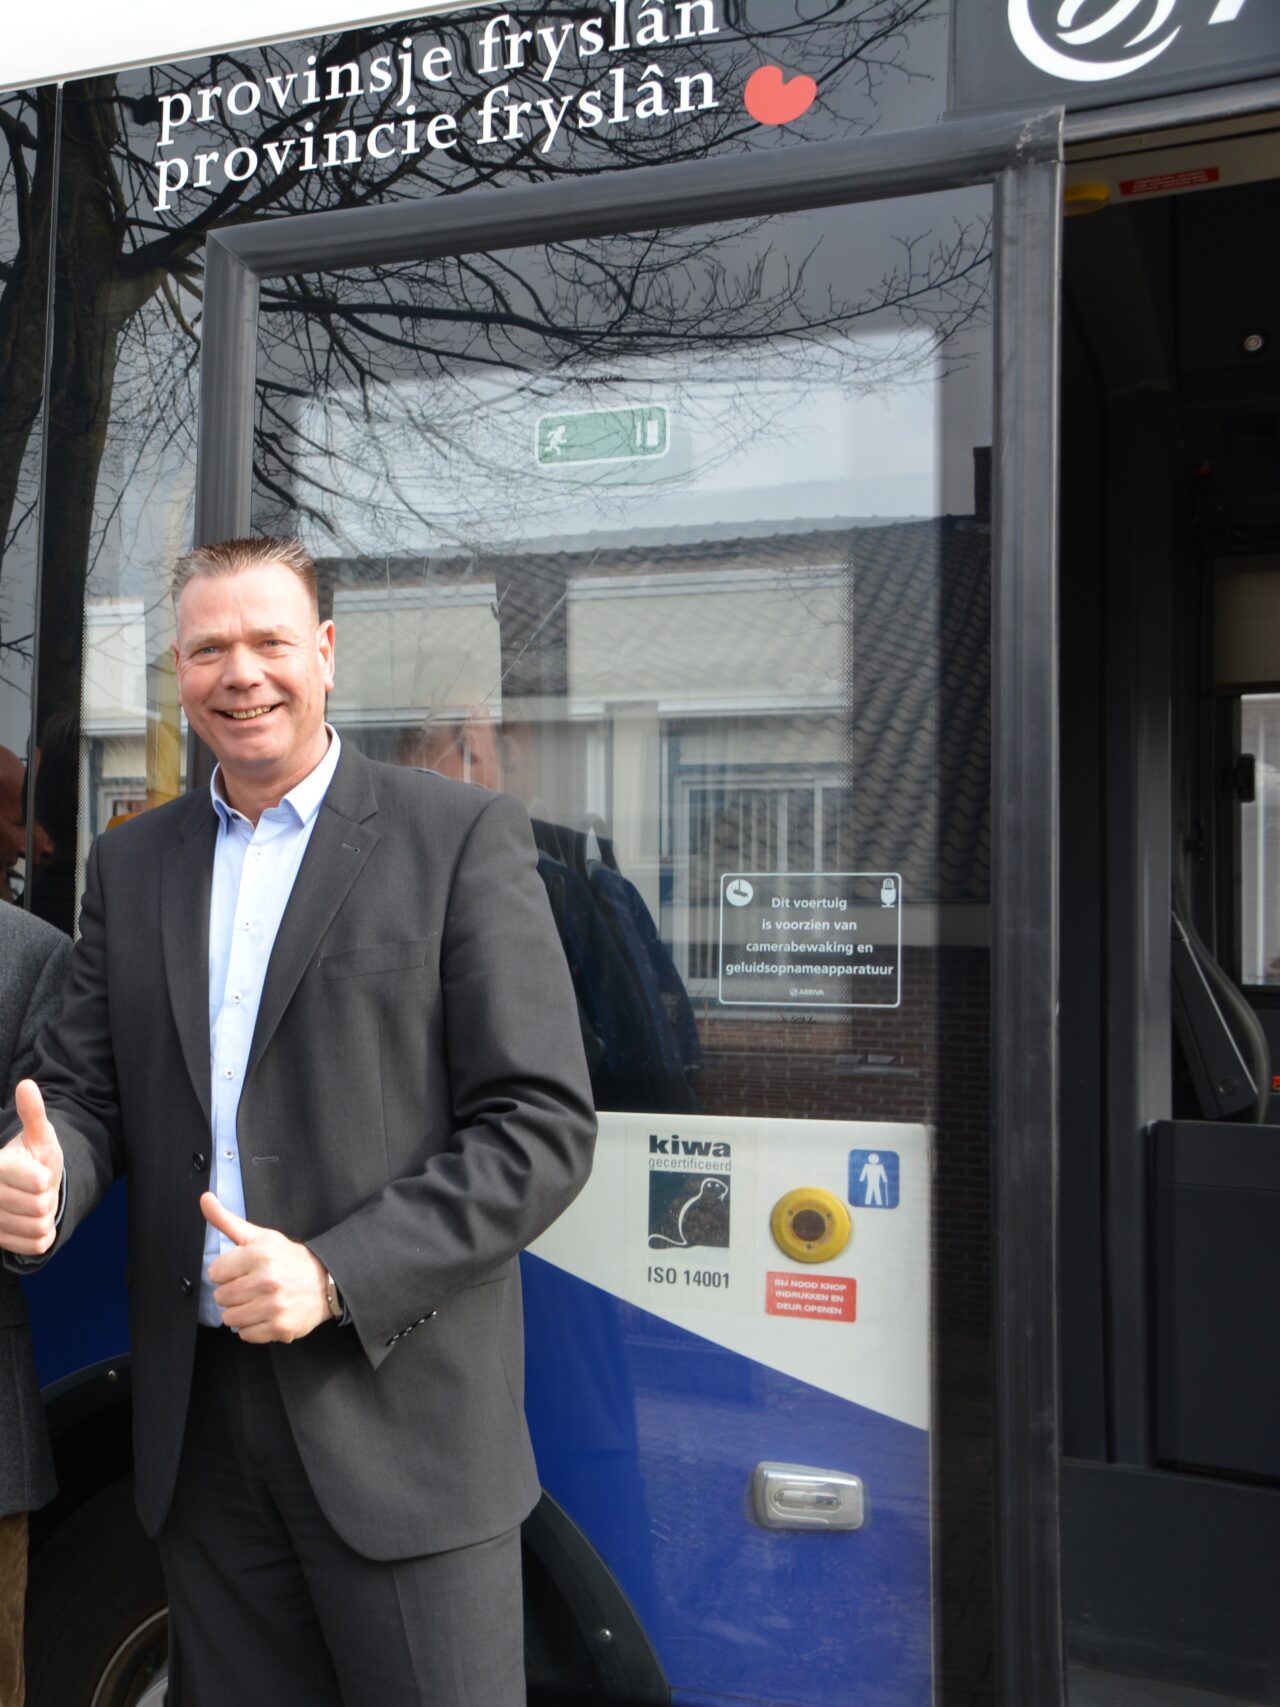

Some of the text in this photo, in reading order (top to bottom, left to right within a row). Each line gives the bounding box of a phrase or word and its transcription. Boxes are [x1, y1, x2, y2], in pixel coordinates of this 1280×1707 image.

[156, 0, 720, 147] provinsje fryslân
[153, 63, 719, 212] provincie fryslân
[771, 896, 847, 911] Dit voertuig
[762, 918, 857, 930] is voorzien van
[746, 940, 873, 955] camerabewaking en
[725, 961, 894, 976] geluidsopnameapparatuur
[649, 1134, 731, 1158] kiwa
[648, 1156, 732, 1171] gecertificeerd
[648, 1266, 729, 1289] ISO 14001
[790, 1280, 818, 1290] NOOD
[820, 1283, 847, 1291] KNOP
[775, 1290, 844, 1303] INDRUKKEN EN
[776, 1302, 842, 1315] DEUR OPENEN
